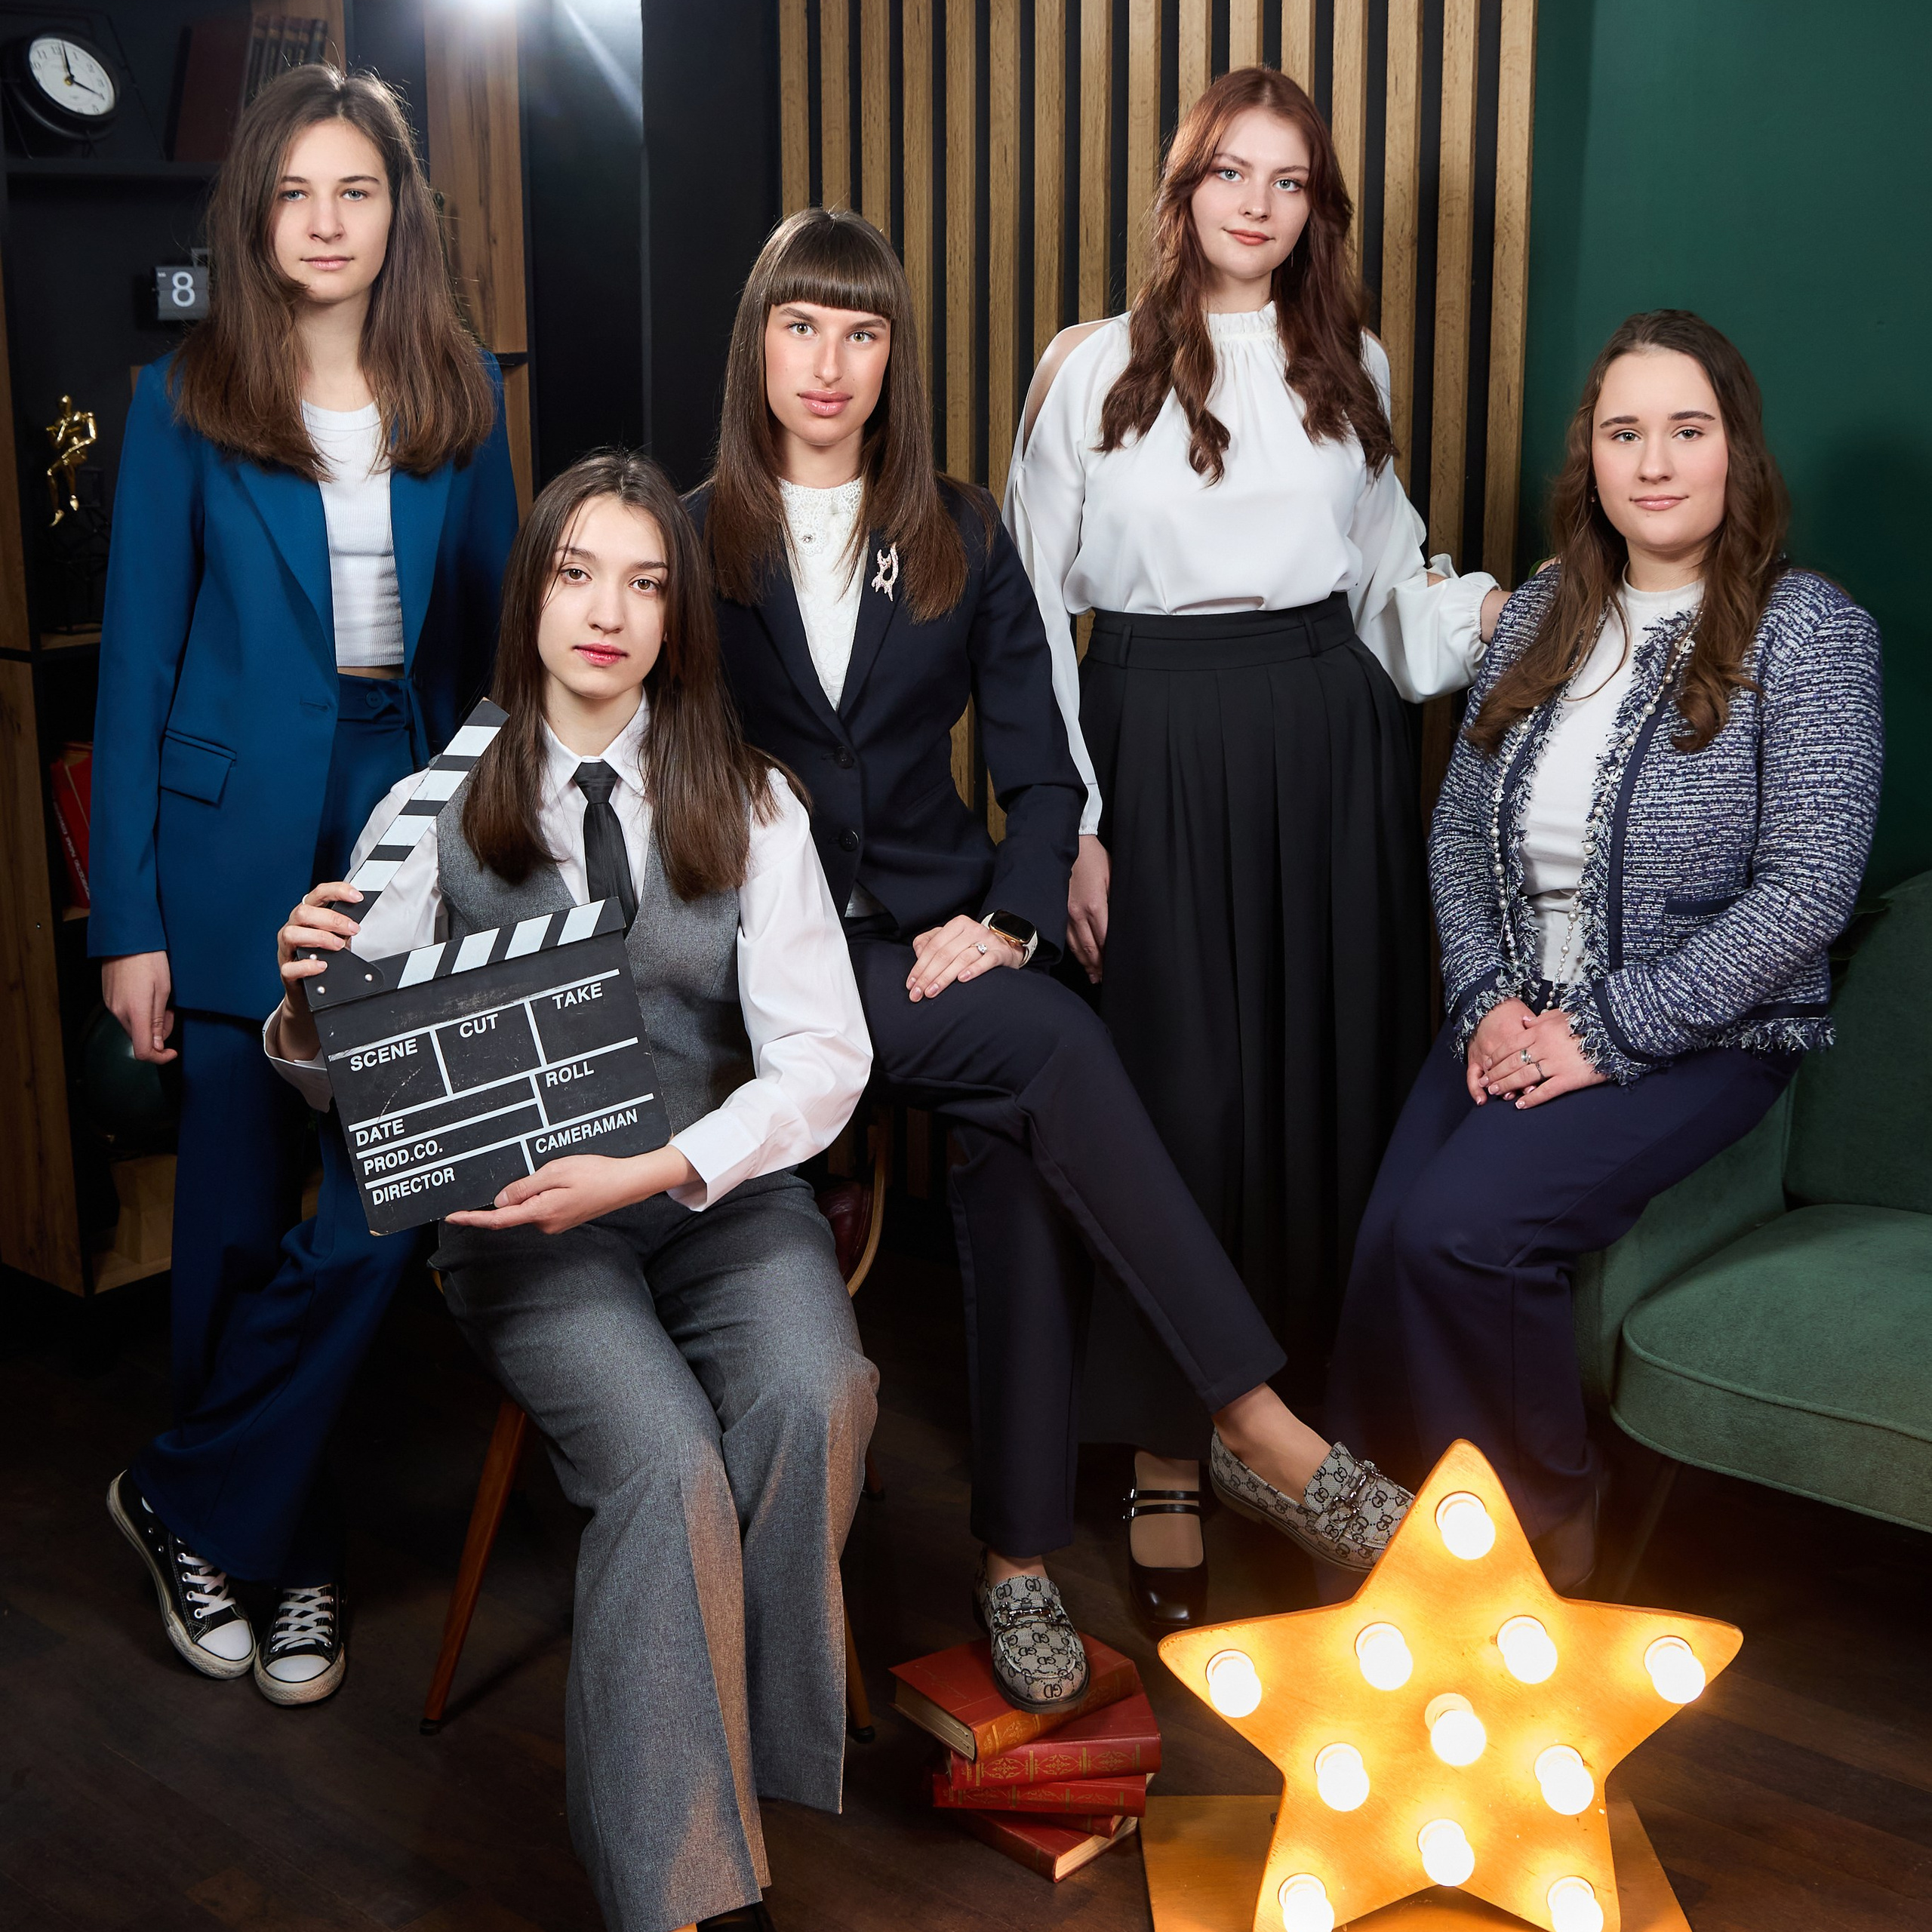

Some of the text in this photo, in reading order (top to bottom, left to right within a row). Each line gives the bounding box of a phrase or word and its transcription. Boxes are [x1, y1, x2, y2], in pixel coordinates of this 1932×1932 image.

[36, 49, 48, 60] 11
[72, 51, 79, 61] 1
[171, 271, 195, 308] 8
[552, 982, 603, 1010] TAKE
[459, 1013, 499, 1038] CUT
[350, 1037, 418, 1072] SCENE
[545, 1060, 595, 1088] ROLL
[355, 1118, 405, 1147] DATE
[535, 1108, 638, 1154] CAMERAMAN
[363, 1139, 444, 1176] PROD.CO.
[372, 1167, 456, 1206] DIRECTOR
